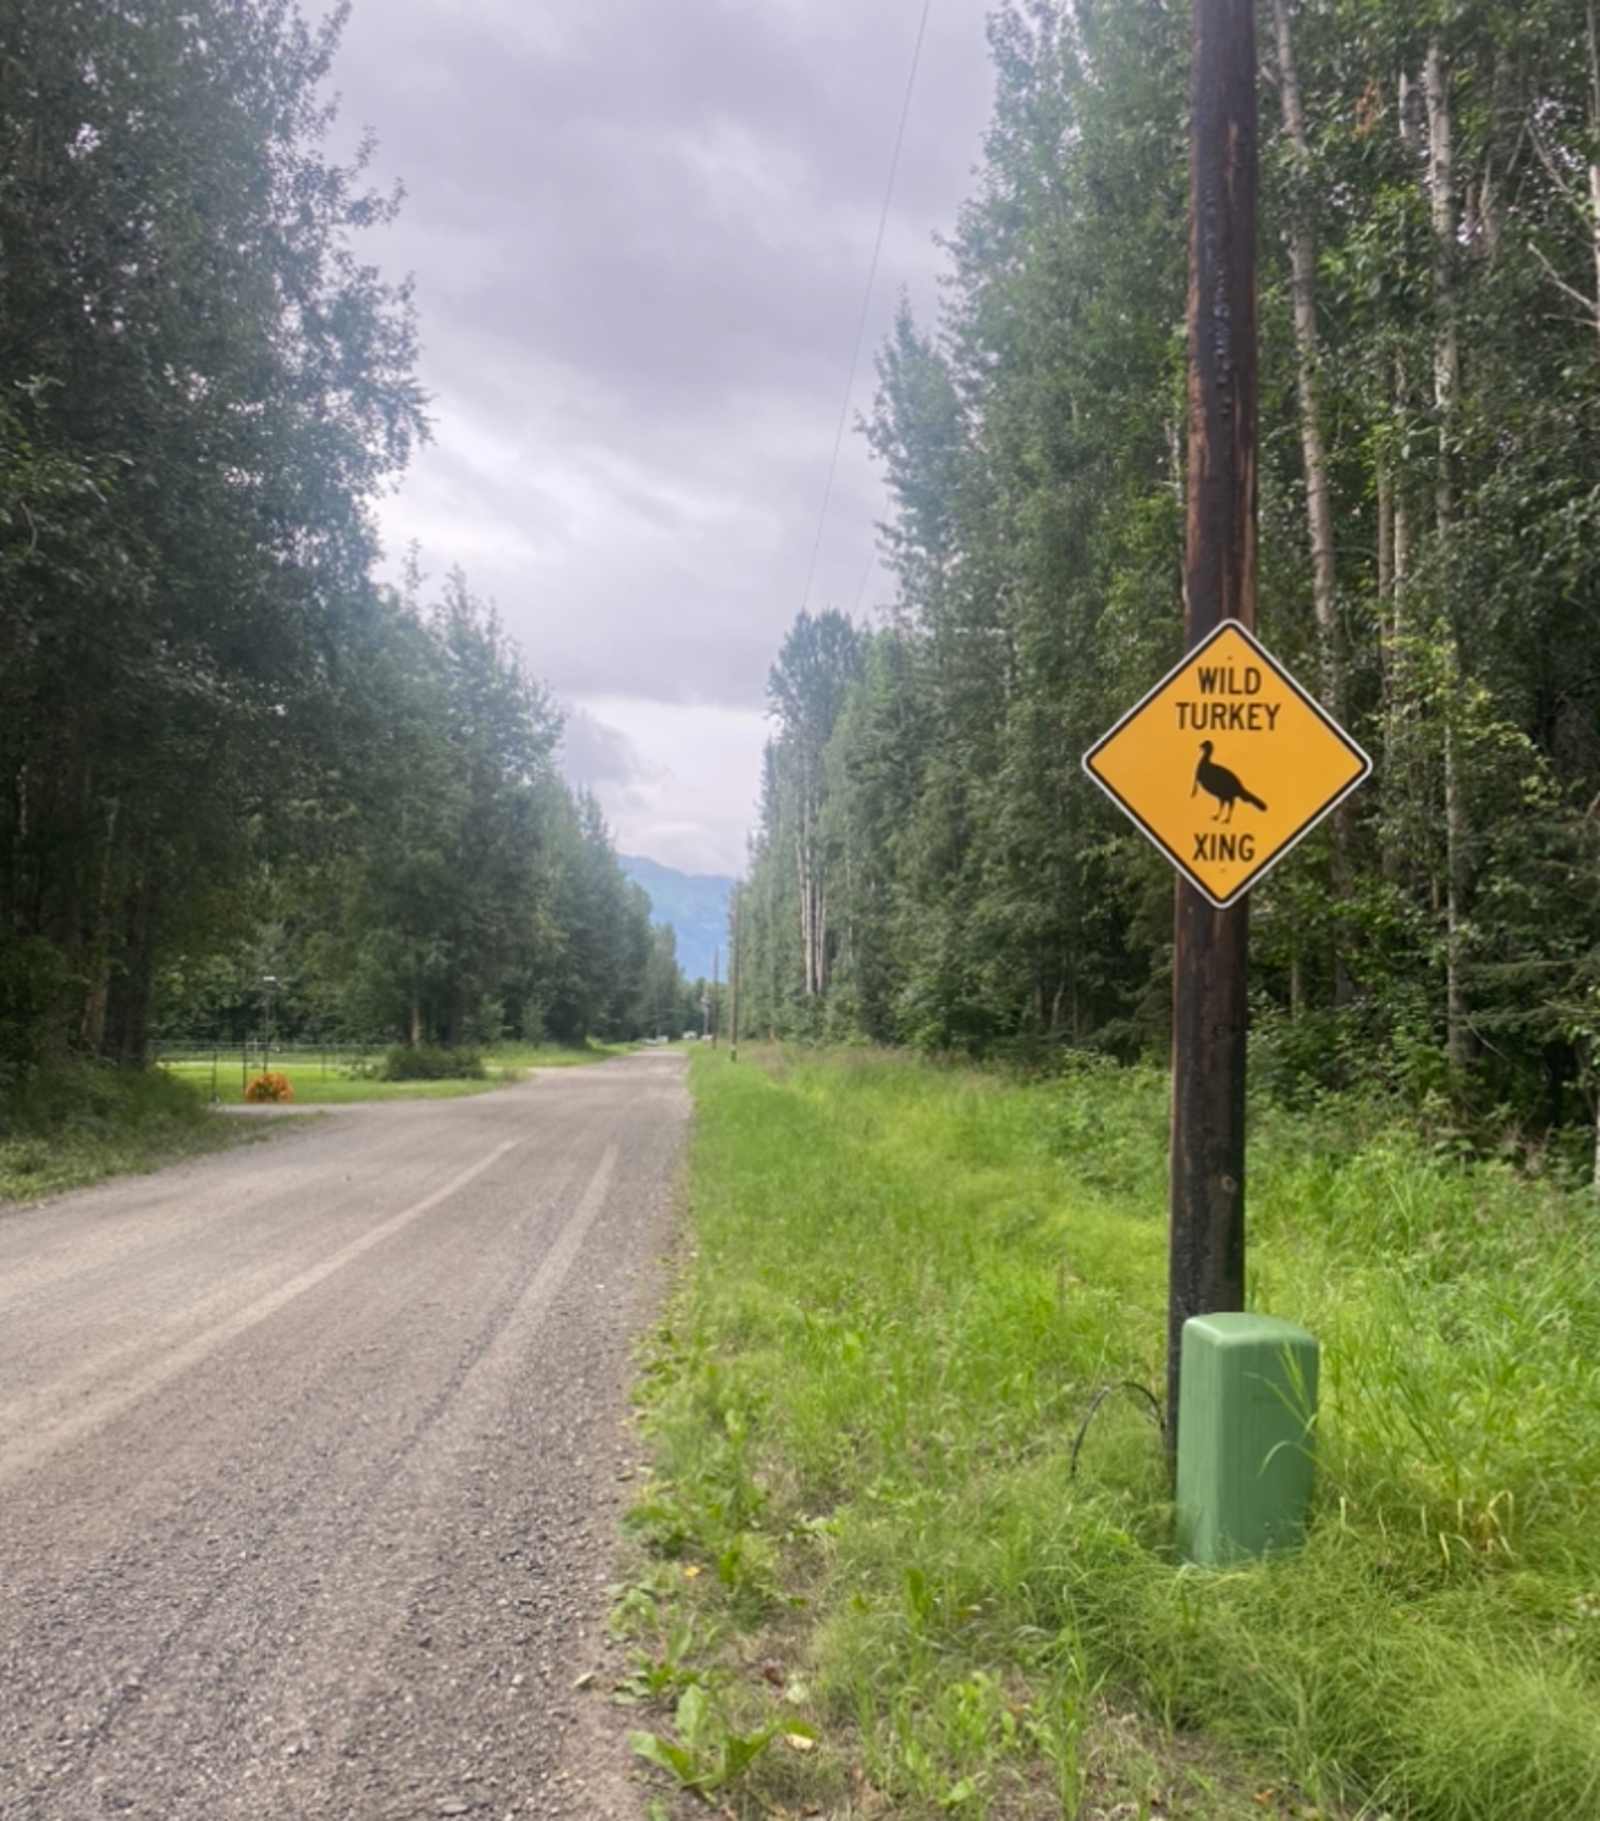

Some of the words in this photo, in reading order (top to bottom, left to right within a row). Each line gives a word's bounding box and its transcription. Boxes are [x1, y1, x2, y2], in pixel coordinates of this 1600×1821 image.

[1197, 667, 1261, 695] WILD
[1176, 702, 1281, 731] TURKEY
[1193, 833, 1255, 861] XING
